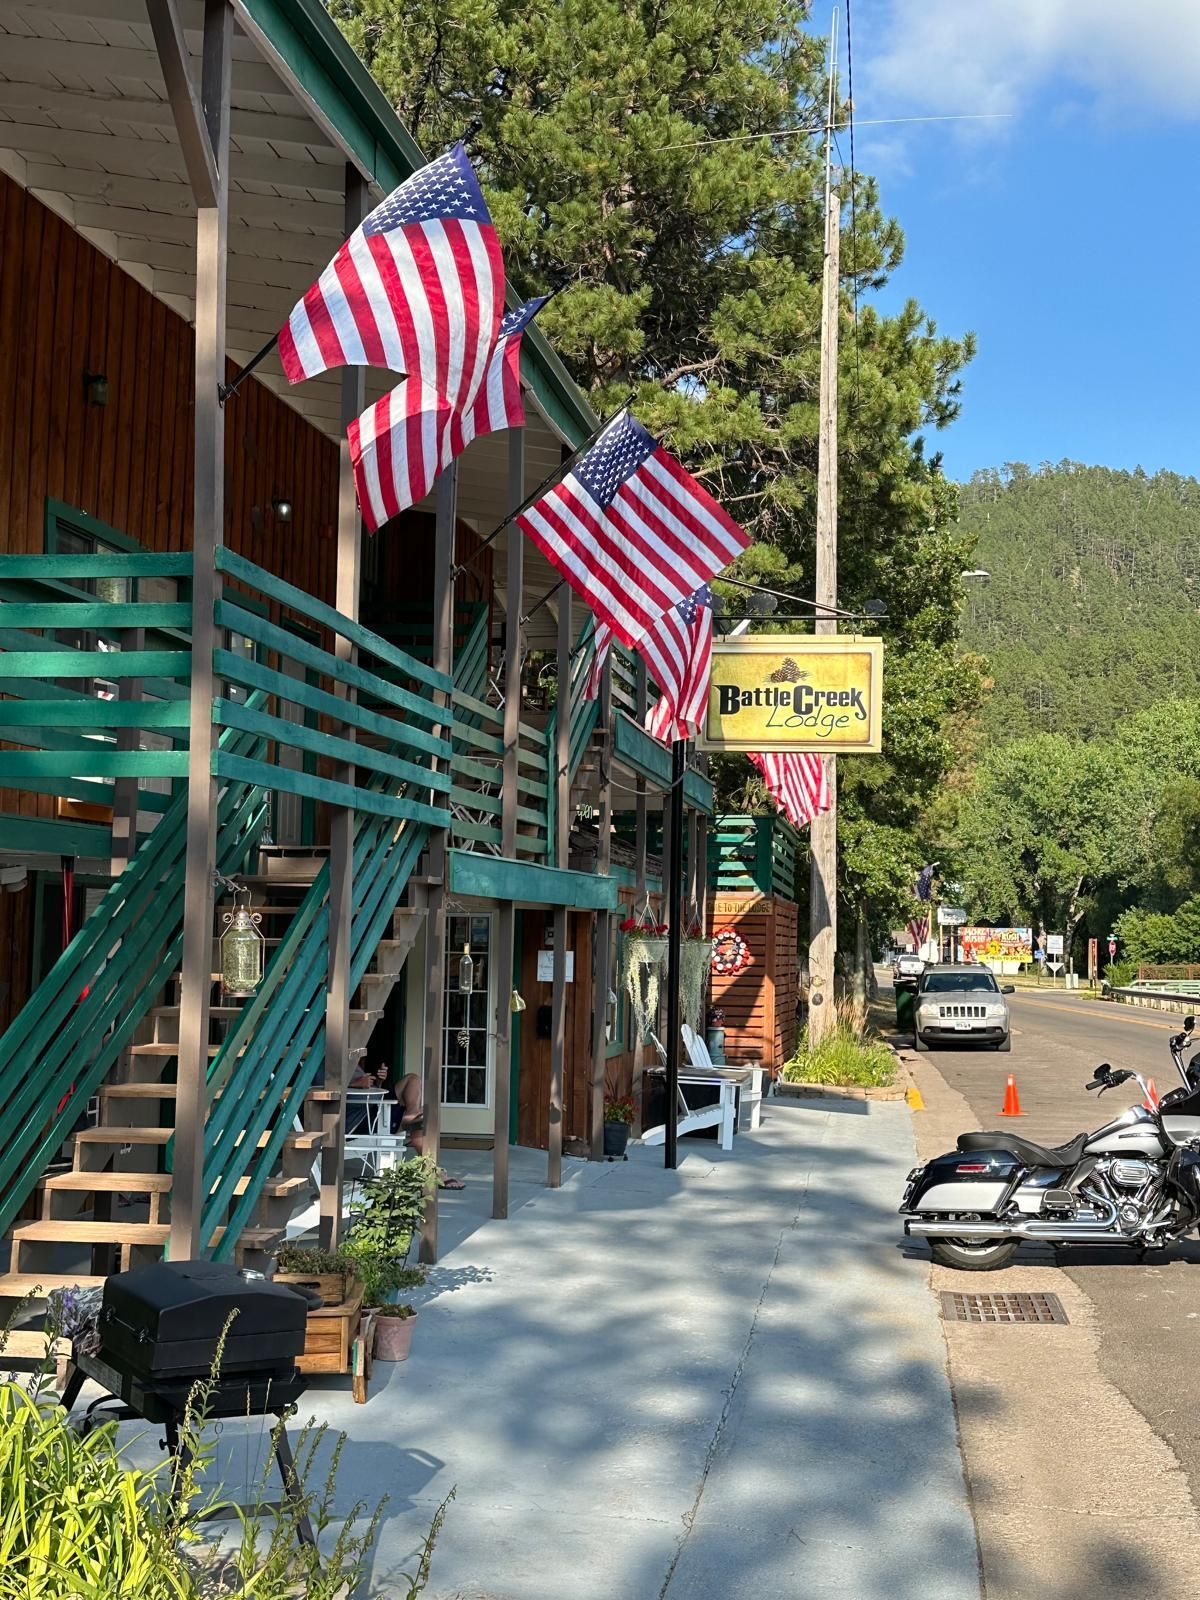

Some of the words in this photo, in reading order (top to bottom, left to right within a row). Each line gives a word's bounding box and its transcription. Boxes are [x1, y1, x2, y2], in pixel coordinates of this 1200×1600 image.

[712, 685, 791, 715] Battle
[793, 685, 867, 720] Creek
[766, 704, 850, 738] Lodge
